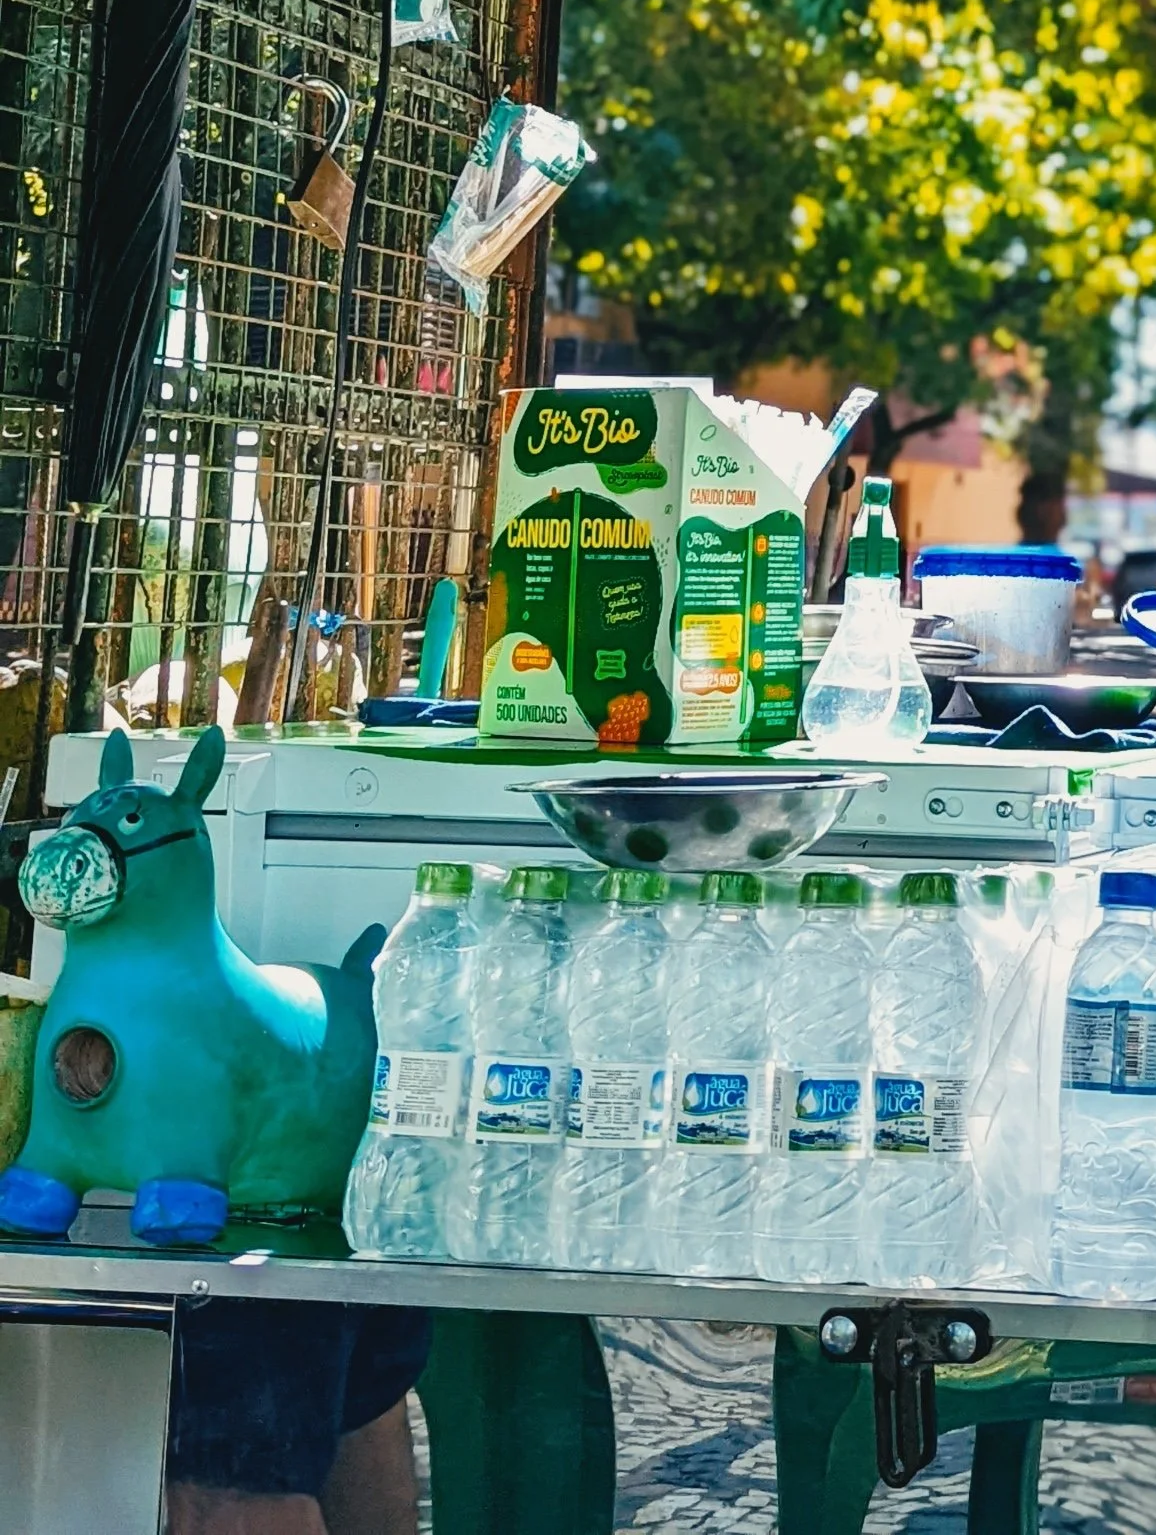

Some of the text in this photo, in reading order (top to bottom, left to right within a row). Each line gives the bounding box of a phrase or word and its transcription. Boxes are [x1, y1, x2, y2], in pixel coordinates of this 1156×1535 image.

[528, 407, 641, 454] It's Bio
[691, 454, 740, 478] It's Bio
[689, 488, 757, 506] CANUDO COMUM
[506, 517, 652, 549] CANUDO COMUM
[496, 684, 526, 700] CONTÉM
[496, 704, 568, 724] 500 UNIDADES
